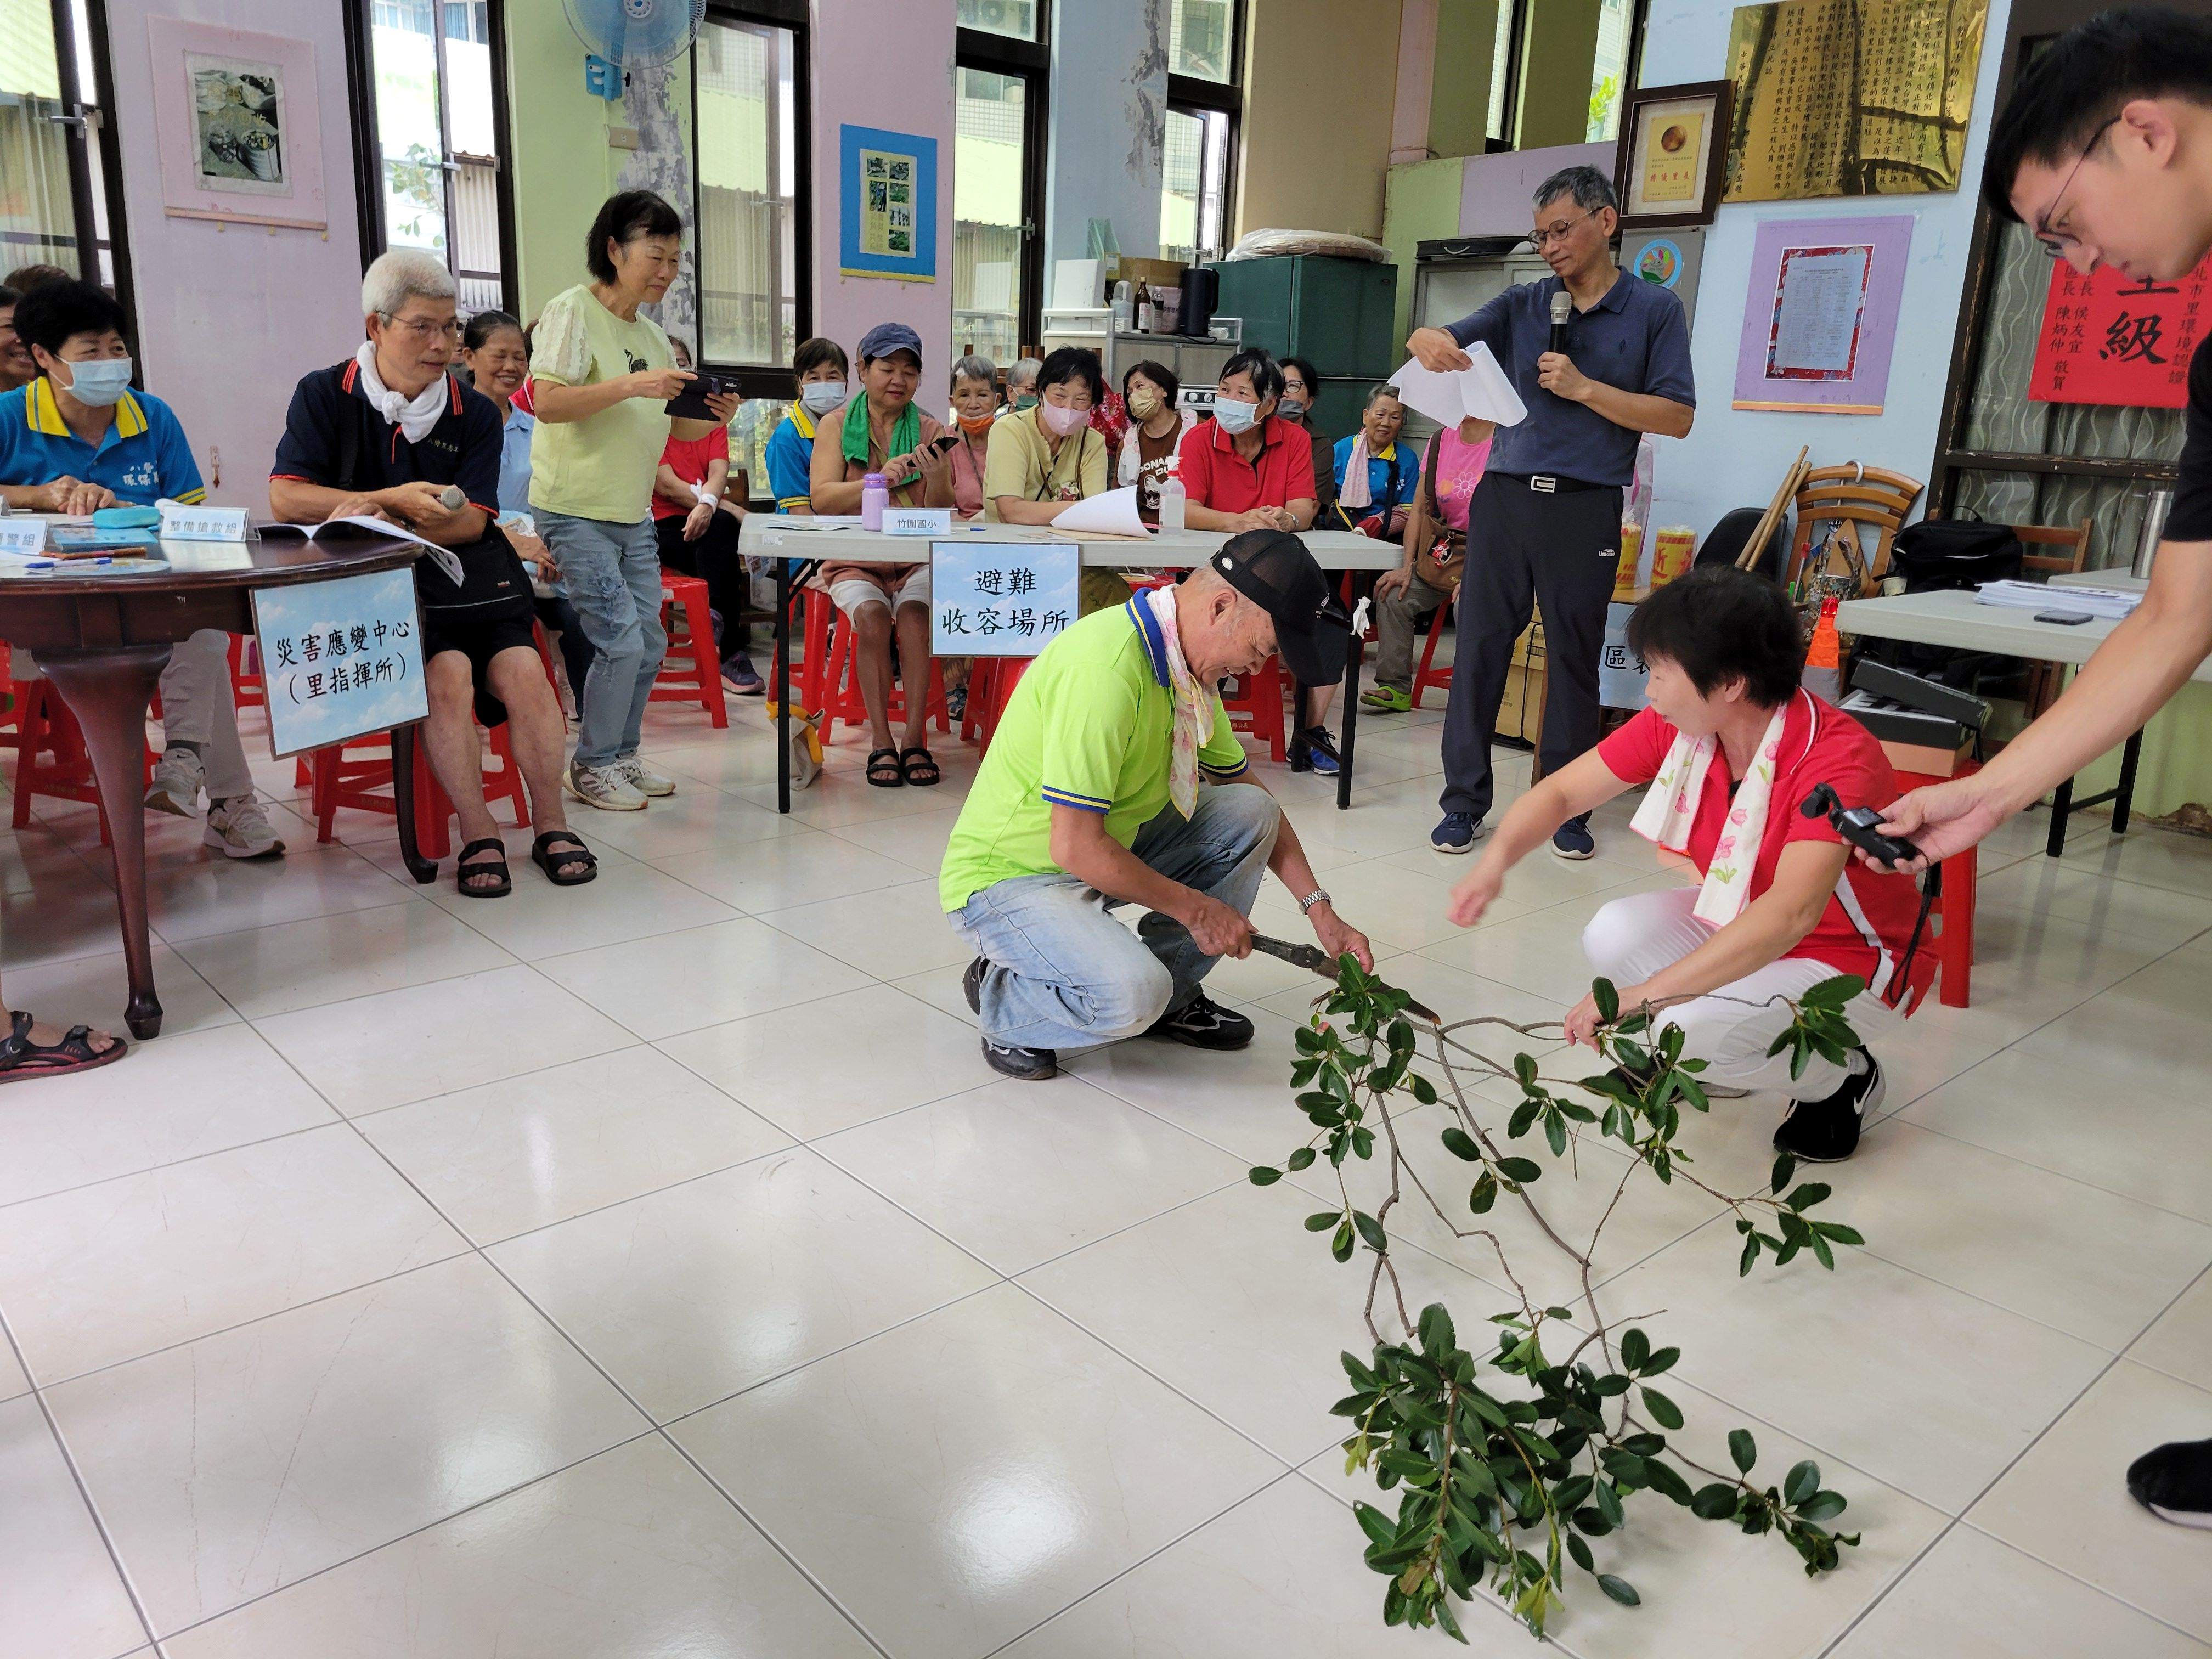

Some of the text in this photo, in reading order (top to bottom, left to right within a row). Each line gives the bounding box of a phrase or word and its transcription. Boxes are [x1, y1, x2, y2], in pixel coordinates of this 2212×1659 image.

[2066, 305, 2089, 354] 侯友宜
[169, 520, 238, 534] 整備搶救組
[896, 518, 937, 529] 竹圍國小
[974, 567, 1037, 596] 避難
[941, 607, 1070, 637] 收容場所
[276, 619, 410, 668] 災害應變中心
